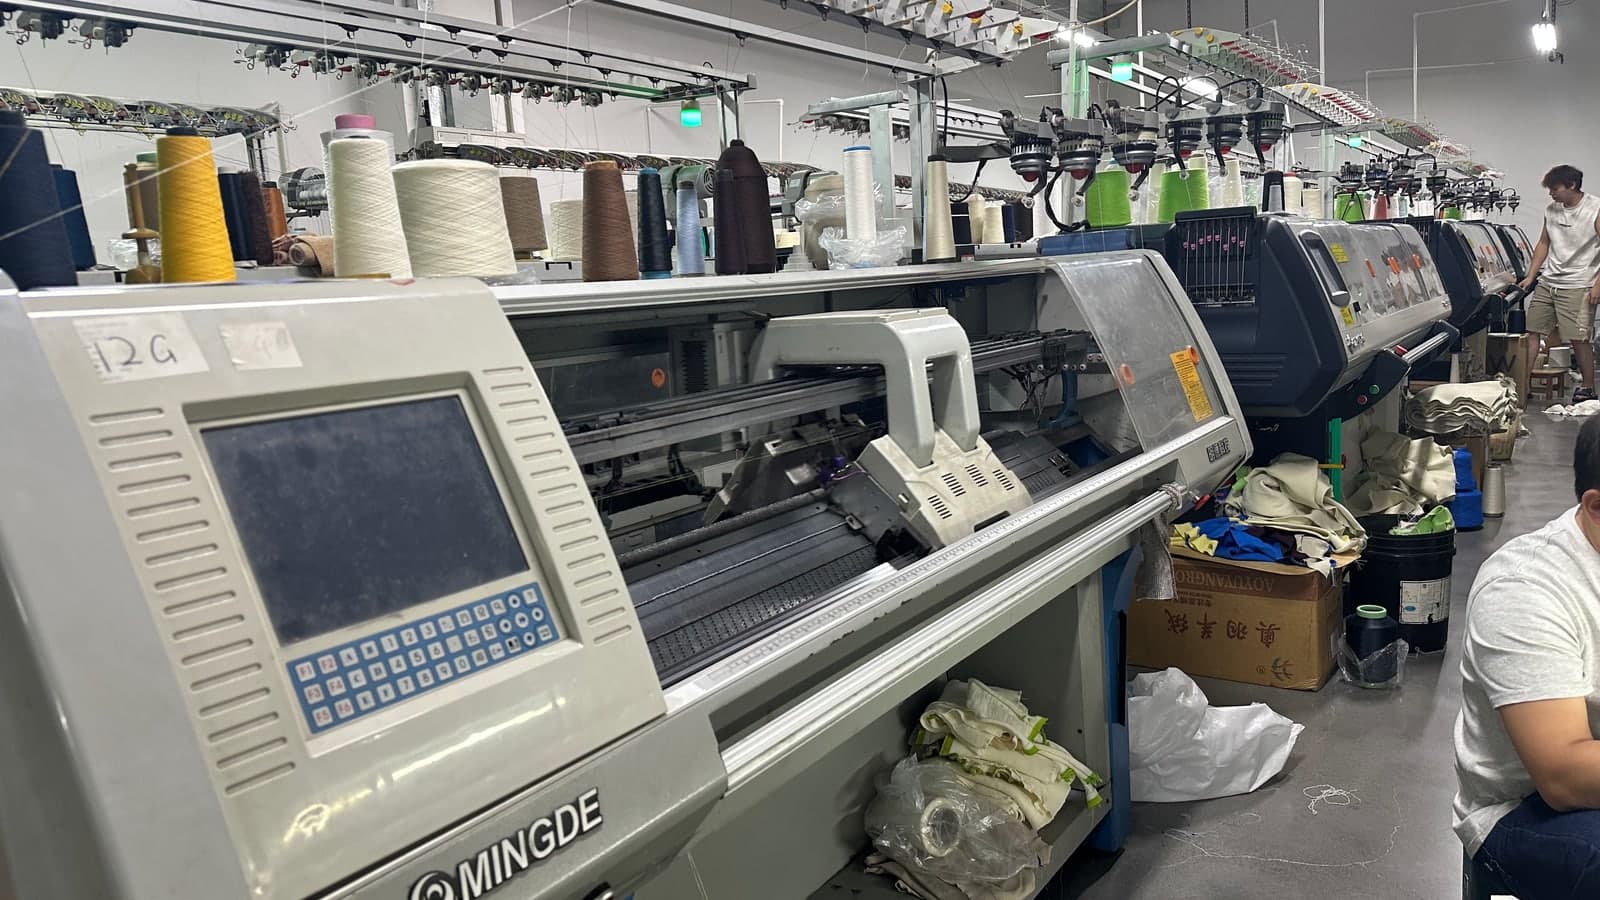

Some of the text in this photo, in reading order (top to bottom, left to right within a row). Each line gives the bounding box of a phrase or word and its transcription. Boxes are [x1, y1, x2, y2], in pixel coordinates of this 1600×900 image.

[299, 665, 313, 678] F1
[320, 658, 335, 671] F2
[404, 631, 416, 643] 2
[423, 624, 434, 637] 3
[307, 686, 321, 699] F3
[330, 678, 344, 691] F4
[413, 651, 424, 663] 5
[432, 645, 442, 657] 6
[315, 709, 330, 722] F5
[337, 701, 352, 714] F6
[421, 672, 431, 684] 8
[439, 665, 450, 677] 9
[456, 787, 603, 900] MINGDE
